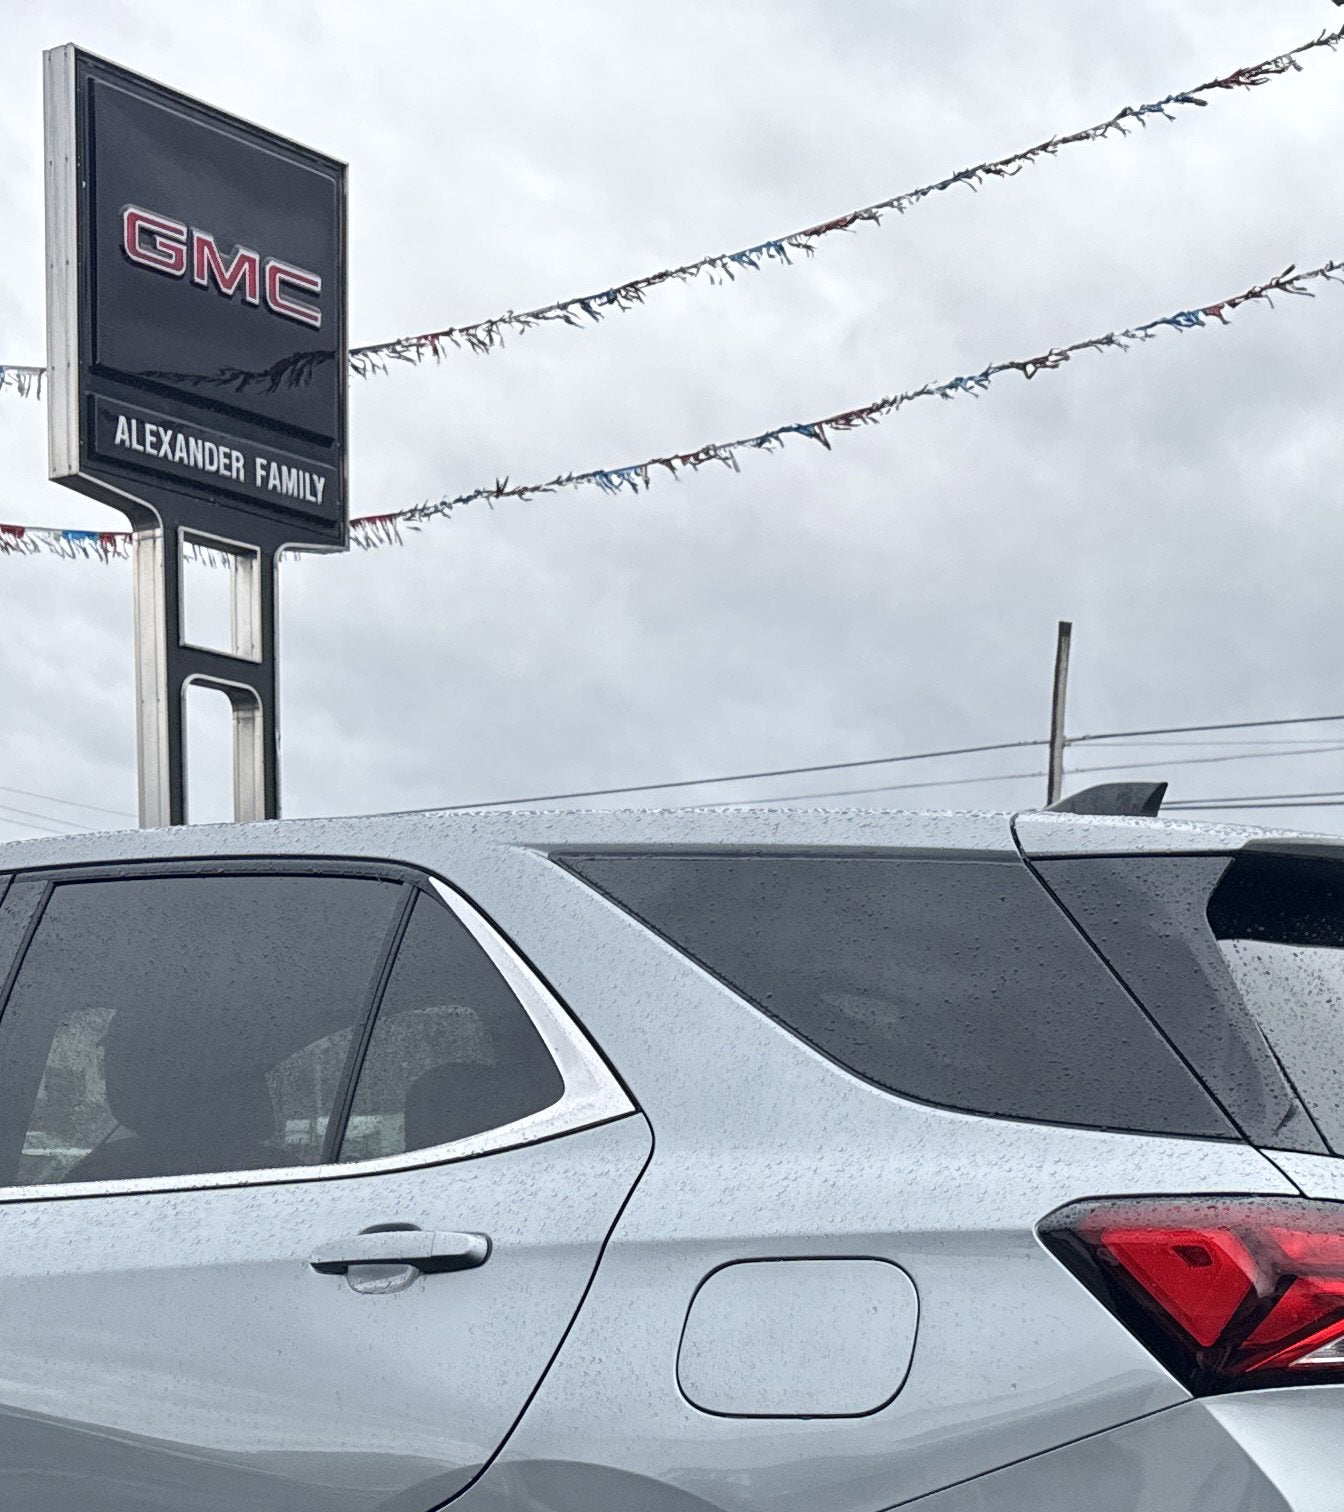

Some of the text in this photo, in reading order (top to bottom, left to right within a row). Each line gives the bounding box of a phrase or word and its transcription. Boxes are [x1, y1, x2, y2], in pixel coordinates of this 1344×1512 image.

[123, 205, 322, 328] GMC
[115, 415, 327, 505] ALEXANDER FAMILY
